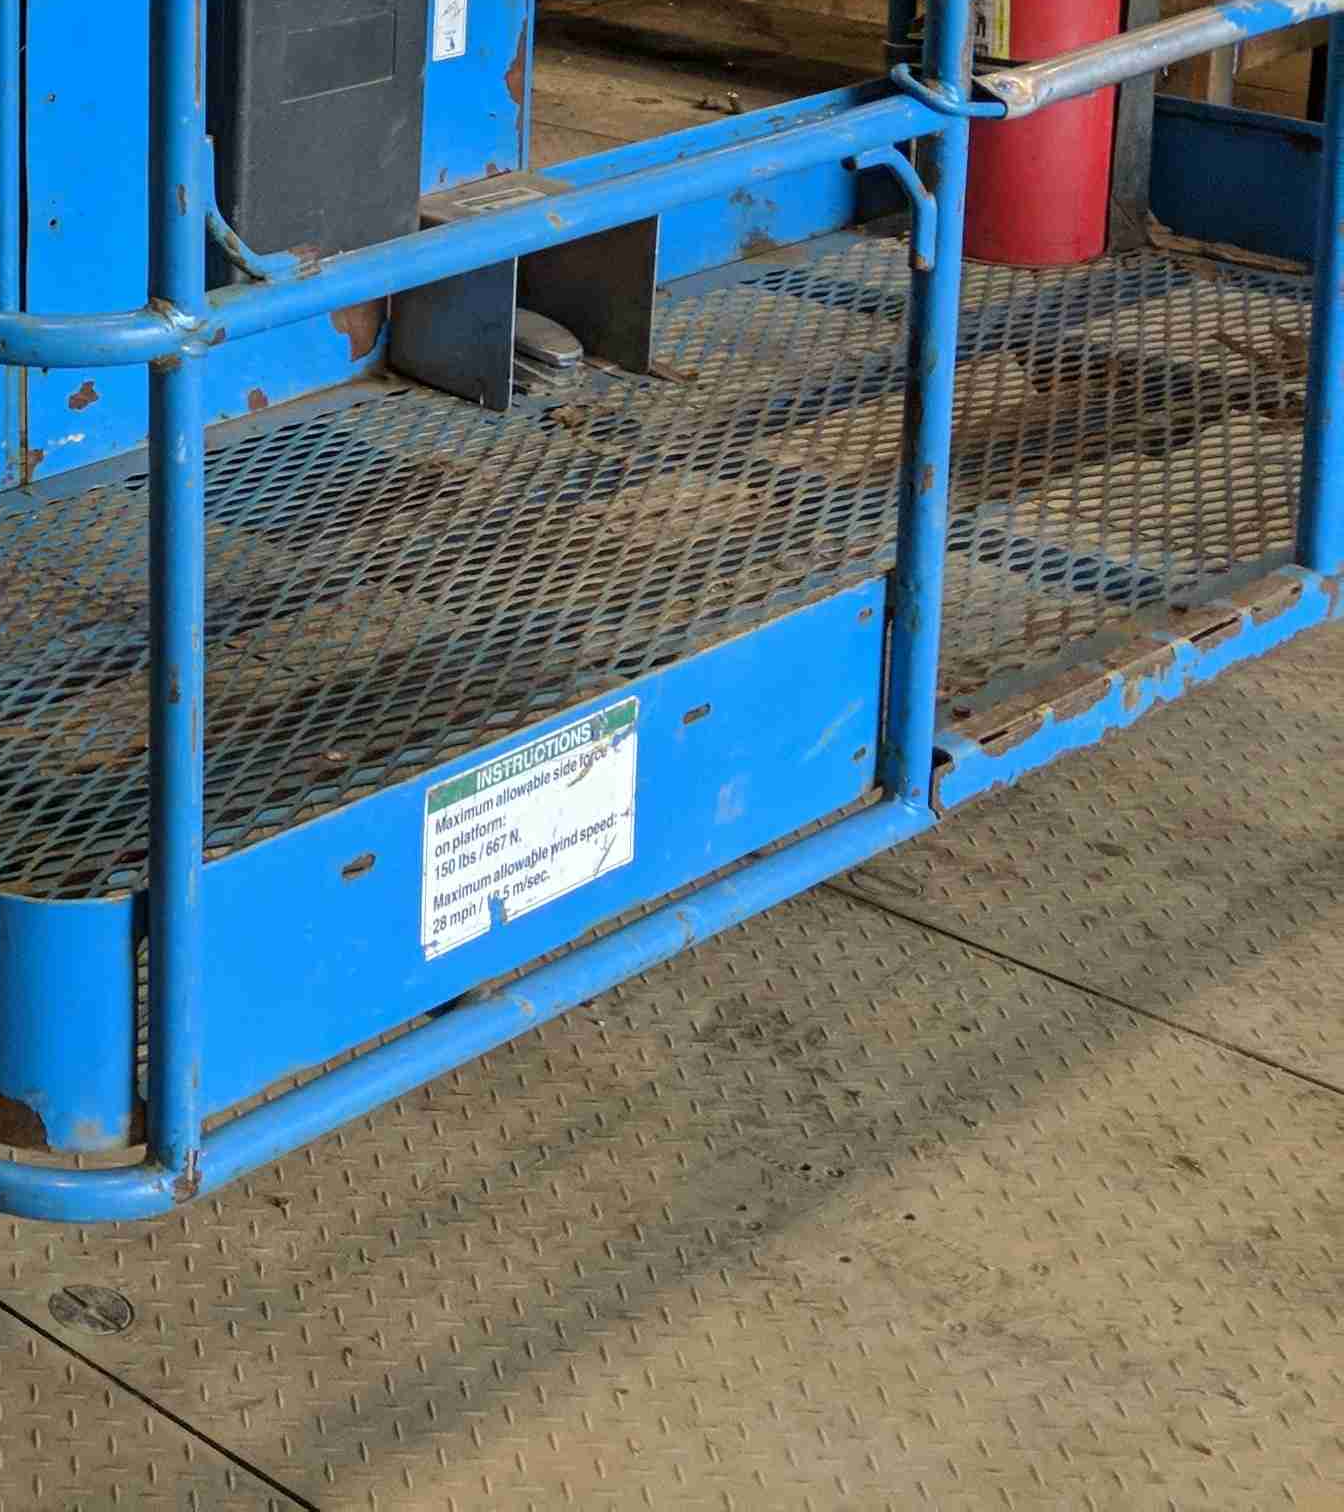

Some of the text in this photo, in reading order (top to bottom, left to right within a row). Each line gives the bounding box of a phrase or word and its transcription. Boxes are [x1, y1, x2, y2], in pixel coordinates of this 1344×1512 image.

[435, 745, 608, 835] Maximum allowable side force
[476, 723, 593, 791] INSTRUCTIONS
[433, 813, 618, 912] Maximum allowable wind speed:
[435, 815, 507, 857] on platform:
[435, 858, 456, 880] 150
[458, 849, 477, 870] lbs
[486, 835, 507, 857] 667
[510, 828, 522, 846] N.
[432, 915, 448, 934] 28
[512, 869, 551, 897] m/sec.
